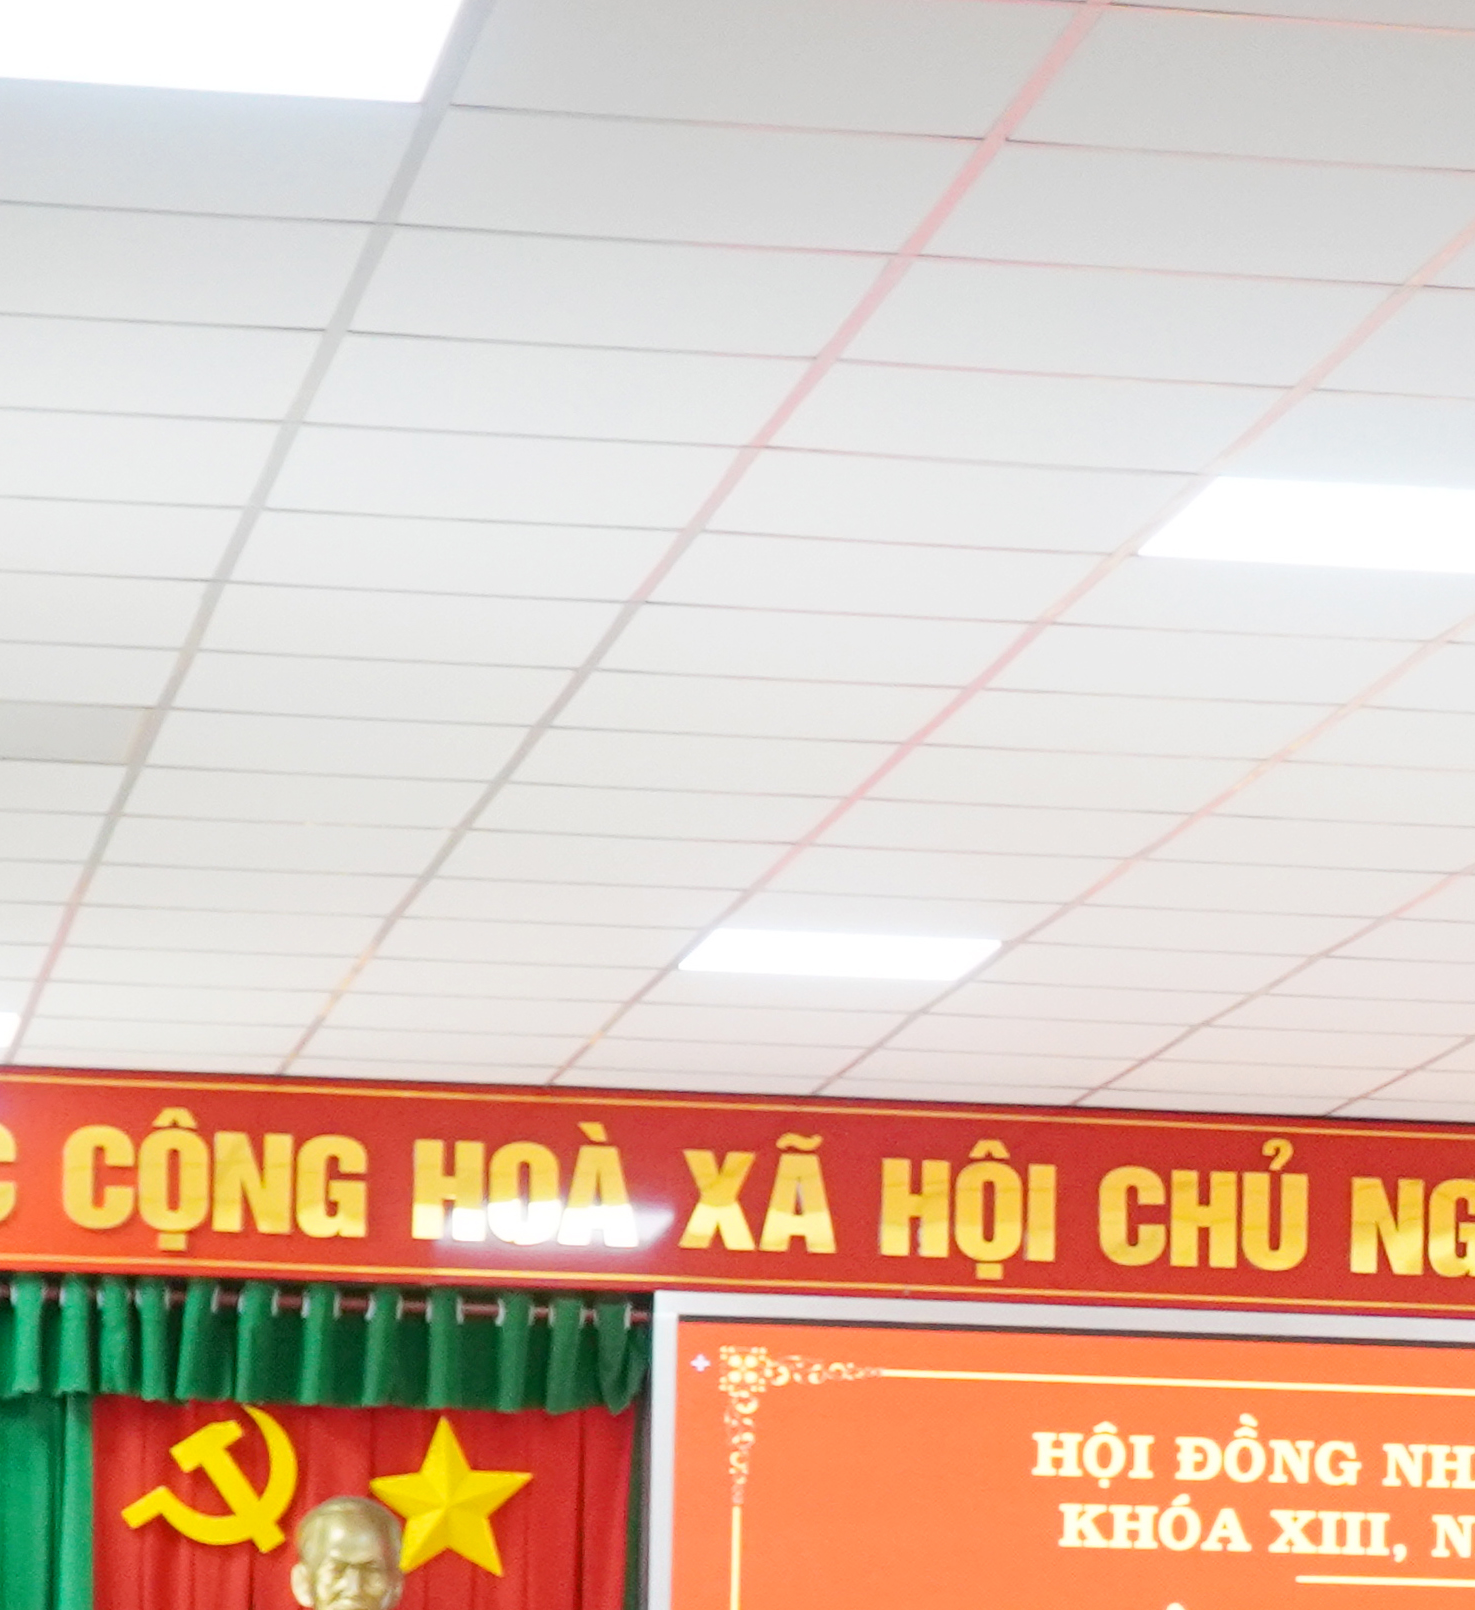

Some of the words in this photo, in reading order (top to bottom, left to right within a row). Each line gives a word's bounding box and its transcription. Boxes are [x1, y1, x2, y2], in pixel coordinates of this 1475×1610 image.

[62, 1107, 367, 1252] CỘNG
[405, 1121, 639, 1249] HOÀ
[679, 1133, 836, 1253] XÃ
[880, 1139, 1057, 1280] HỘI
[1098, 1137, 1309, 1271] CHỦ
[1031, 1422, 1156, 1495] HỘI
[1174, 1412, 1362, 1488] ĐỒNG
[1058, 1494, 1252, 1555] KHÓA
[1268, 1508, 1409, 1566] XIII,
